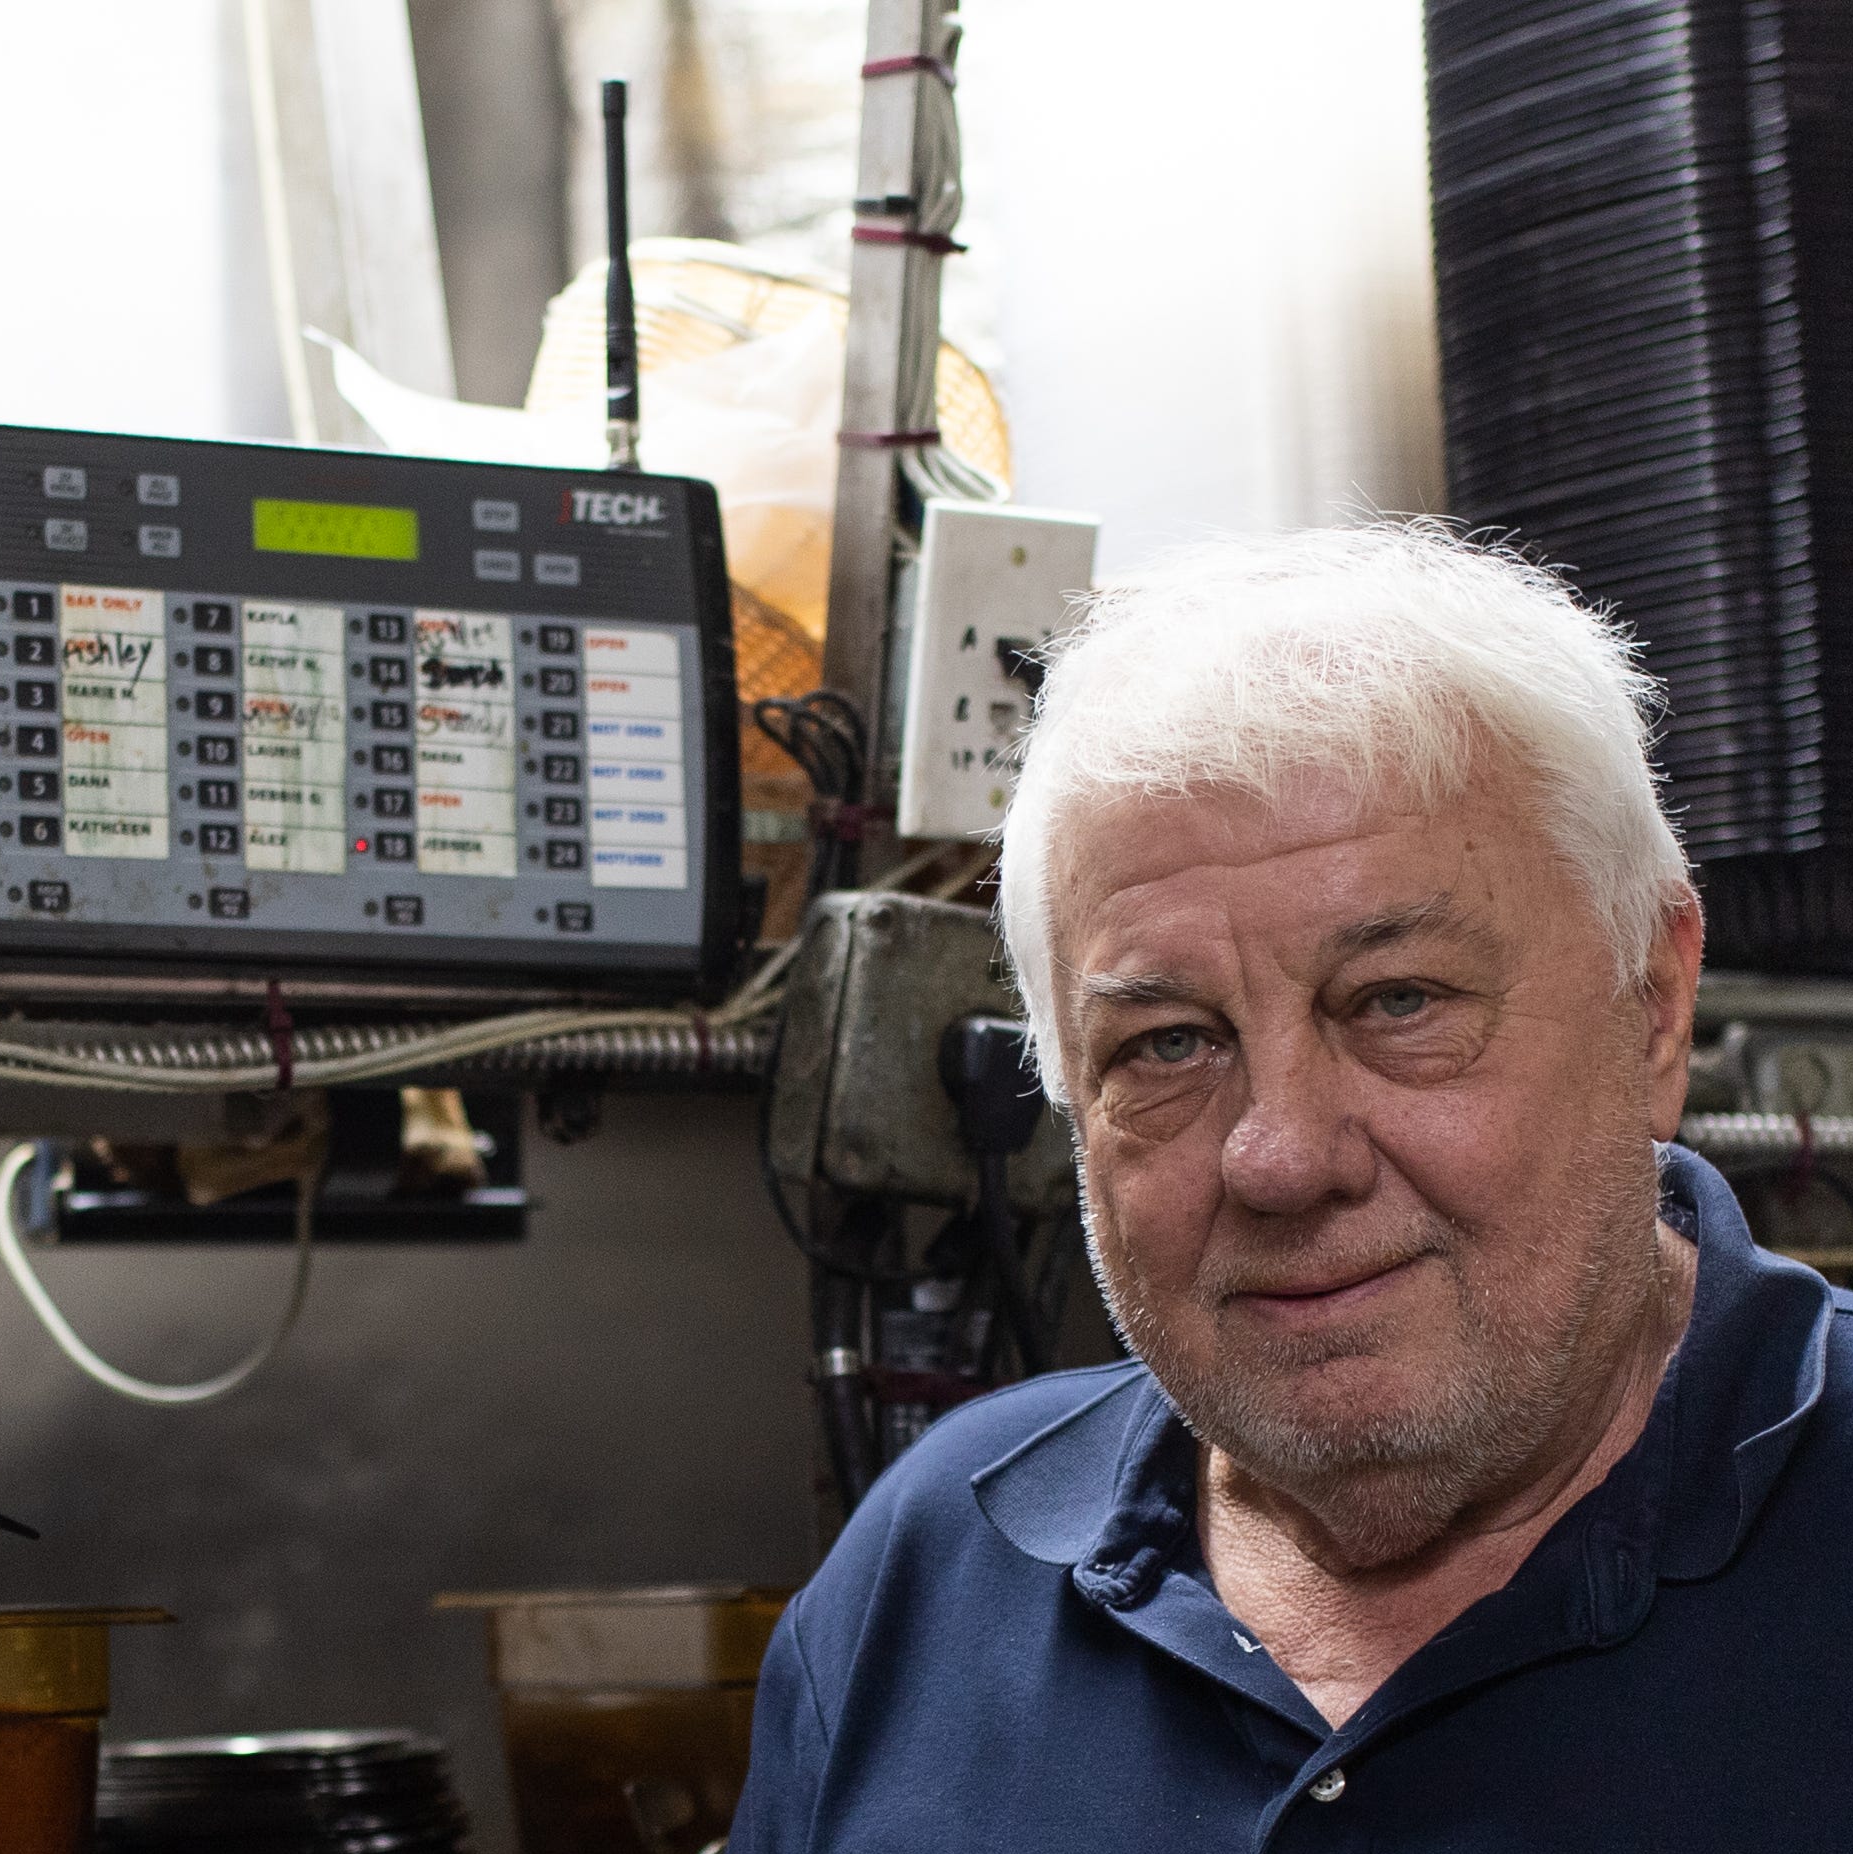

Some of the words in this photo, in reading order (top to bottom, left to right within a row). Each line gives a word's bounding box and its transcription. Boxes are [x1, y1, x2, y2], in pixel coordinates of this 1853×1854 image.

[31, 599, 39, 616] 1
[207, 609, 219, 628] 7
[29, 642, 42, 661] 2
[208, 652, 221, 672] 8
[32, 687, 43, 706] 3
[208, 697, 222, 716] 9
[33, 732, 45, 752] 4
[34, 776, 45, 796] 5
[208, 785, 229, 804] 11
[35, 822, 47, 841] 6
[208, 830, 232, 849] 12
